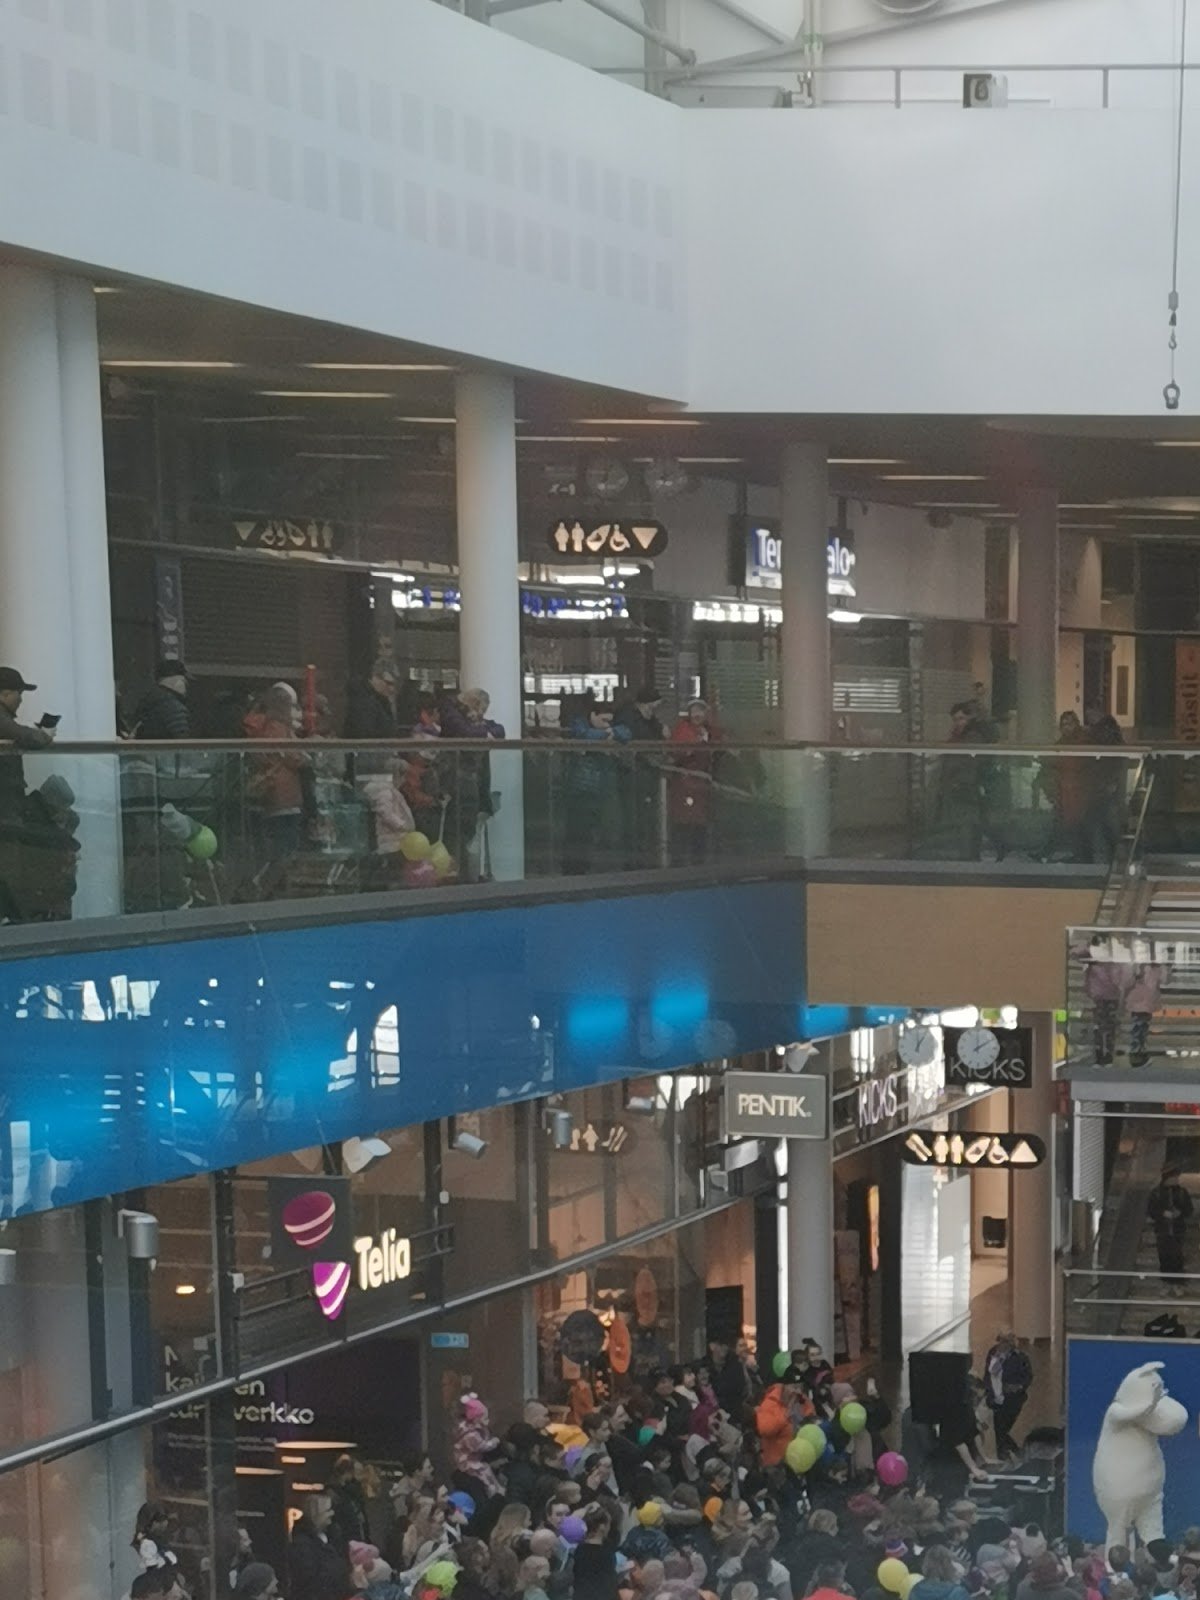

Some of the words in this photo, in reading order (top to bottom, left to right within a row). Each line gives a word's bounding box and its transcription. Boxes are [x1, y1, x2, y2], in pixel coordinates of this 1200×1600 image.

[738, 1093, 807, 1118] PENTIK
[858, 1073, 898, 1128] KICKS
[353, 1227, 411, 1291] Telia
